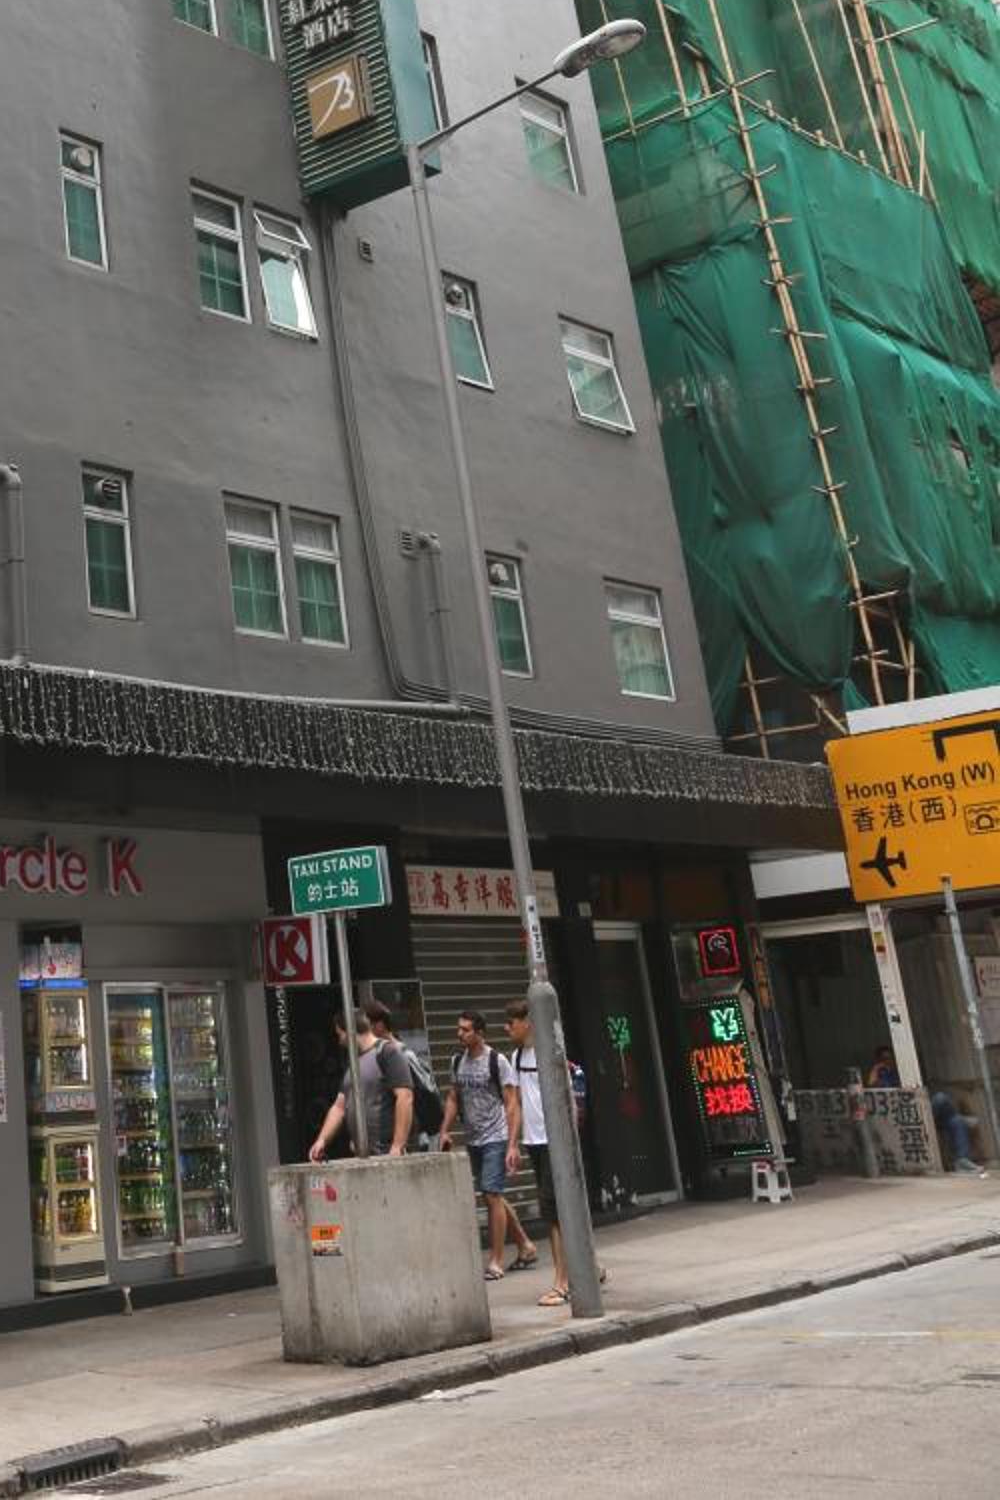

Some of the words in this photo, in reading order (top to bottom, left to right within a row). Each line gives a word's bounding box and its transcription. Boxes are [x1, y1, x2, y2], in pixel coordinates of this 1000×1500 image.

[302, 5, 351, 49] 酒店
[845, 781, 898, 800] Hong
[901, 771, 956, 792] Kong
[961, 761, 995, 786] (W)
[107, 836, 142, 896] K
[292, 862, 319, 878] TAXI
[324, 855, 373, 874] STAND
[307, 878, 360, 902] 的士站
[695, 1045, 748, 1082] CHANGE
